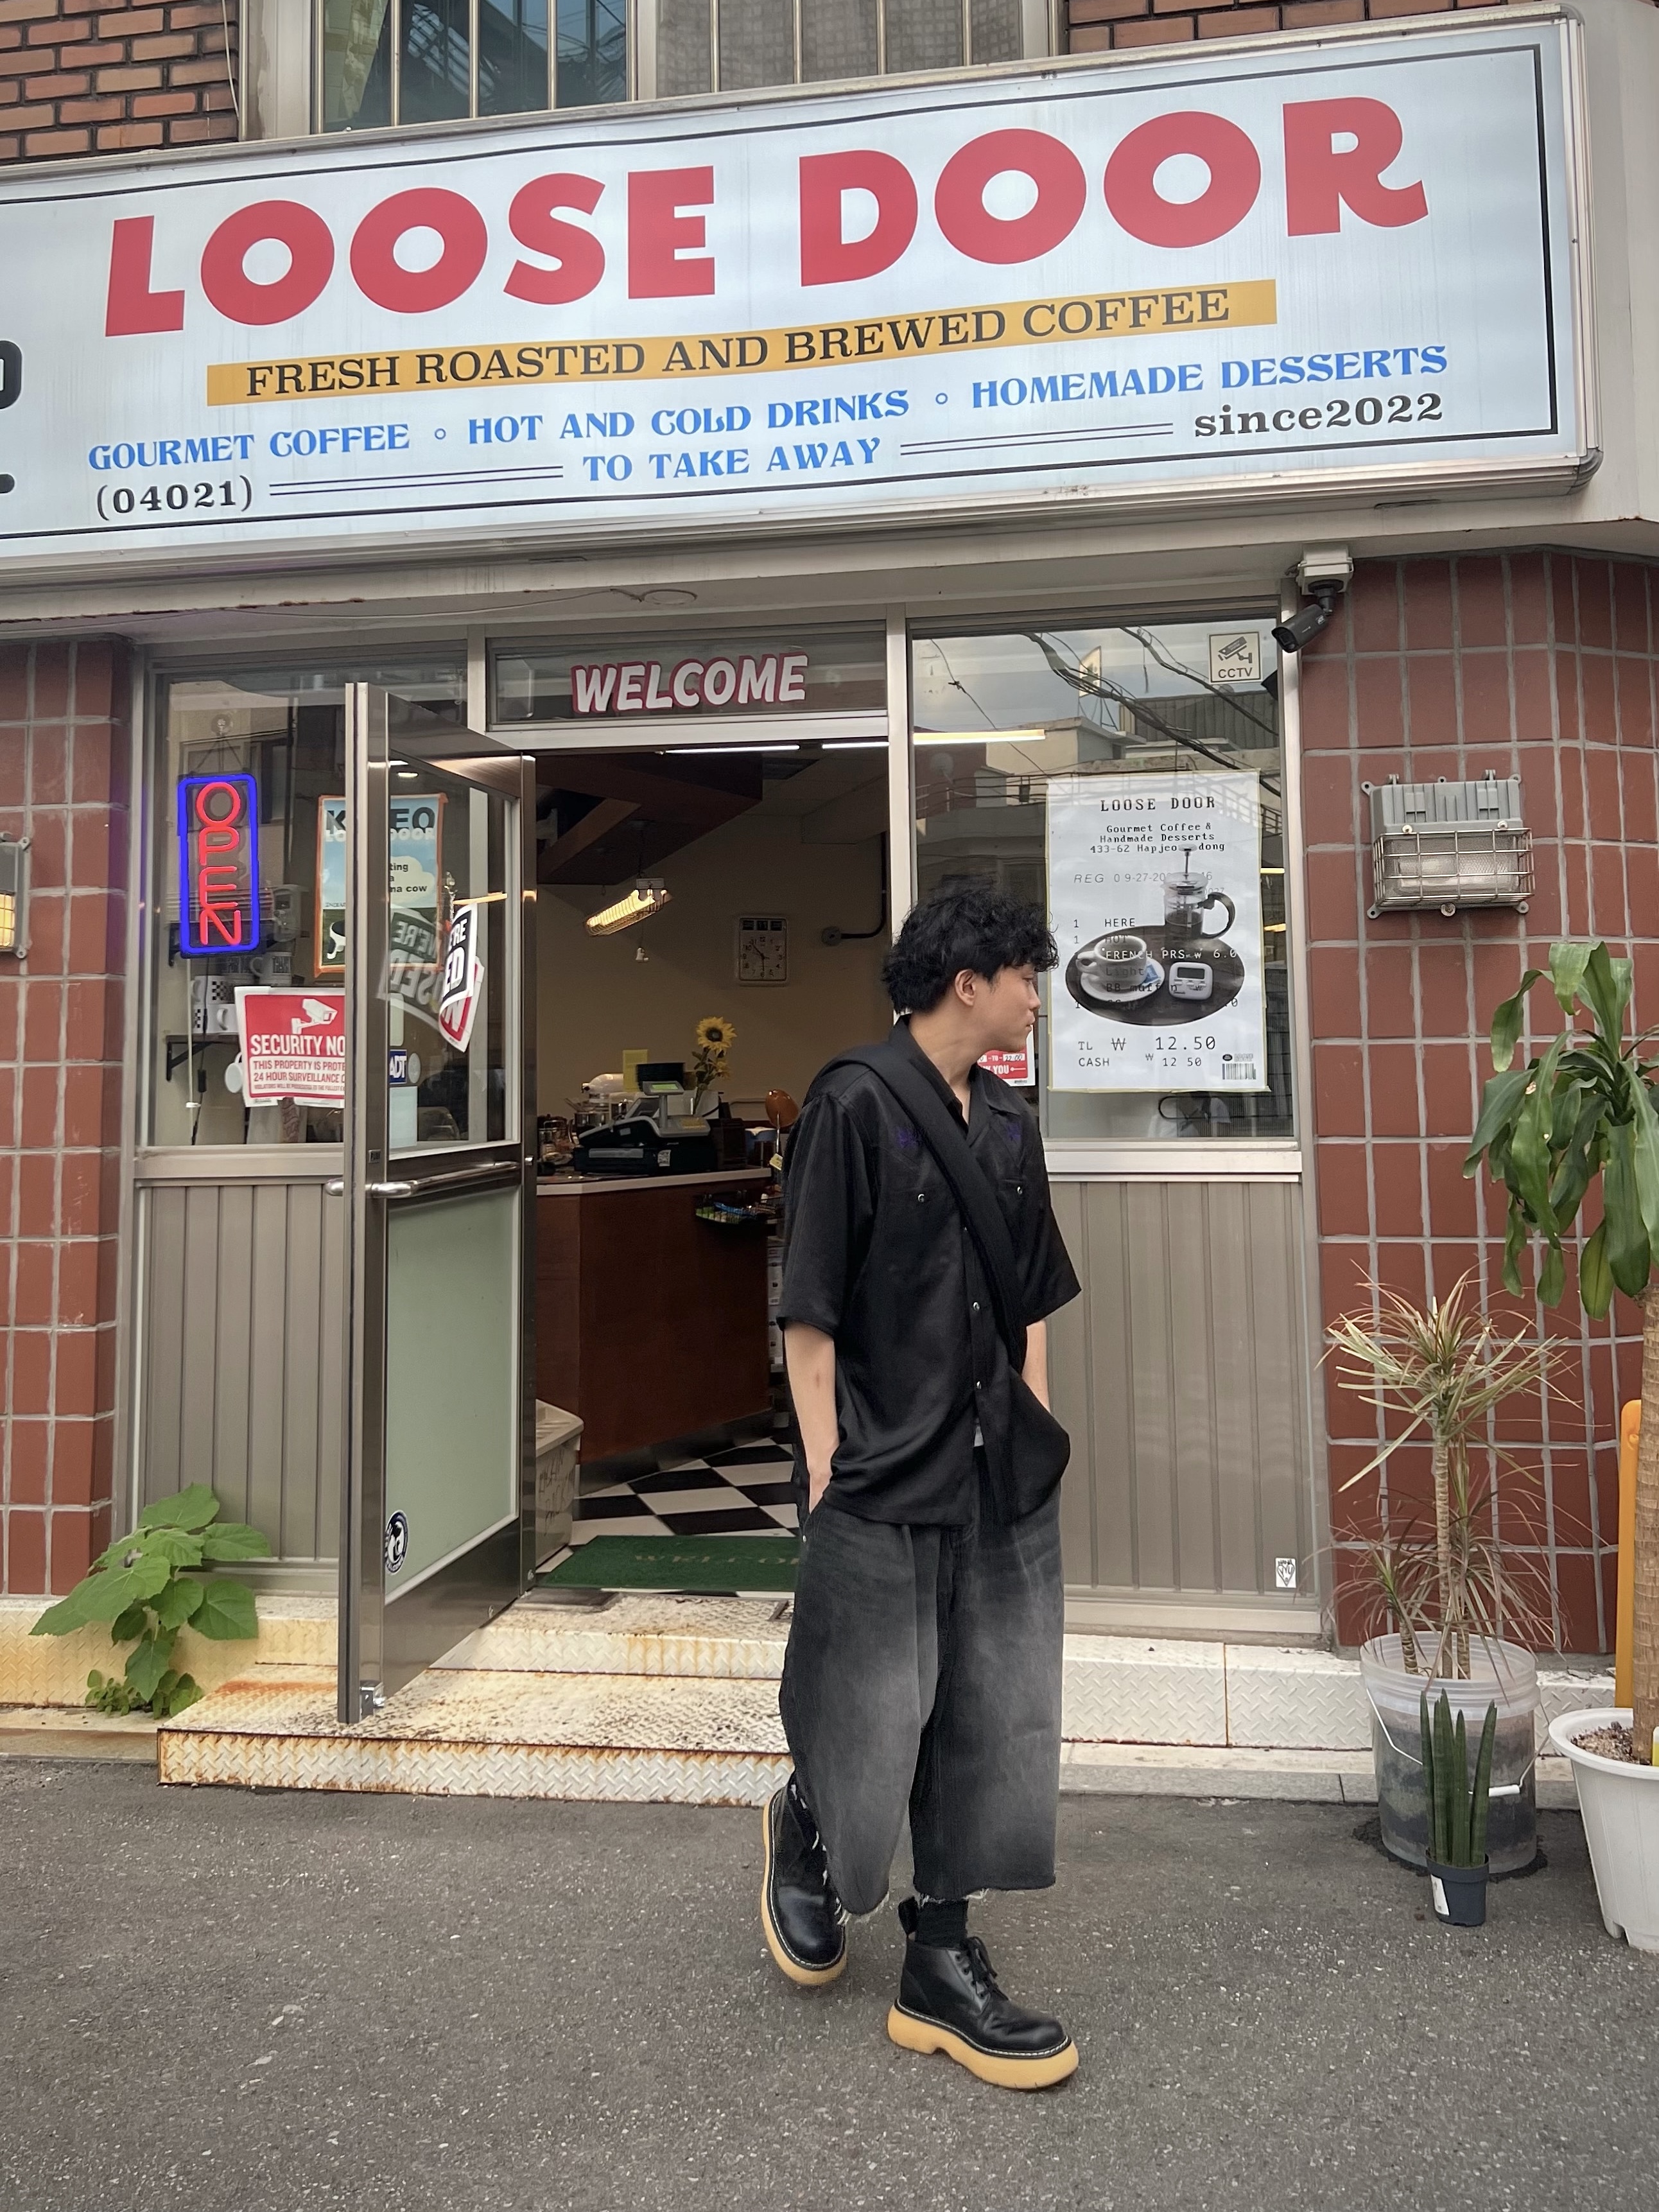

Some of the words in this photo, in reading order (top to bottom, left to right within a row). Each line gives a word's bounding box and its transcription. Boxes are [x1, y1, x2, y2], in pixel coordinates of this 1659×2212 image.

[105, 165, 715, 337] LOOSE
[799, 96, 1429, 287] DOOR
[246, 356, 400, 397] FRESH
[415, 343, 645, 385] ROASTED
[662, 335, 768, 372] AND
[785, 309, 1005, 364] BREWED
[1023, 289, 1229, 337] COFFEE
[89, 434, 255, 470] GOURMET
[270, 424, 410, 457] COFFEE
[468, 415, 543, 444] HOT
[559, 411, 634, 440] AND
[651, 405, 751, 436] COLD
[767, 389, 910, 428] DRINKS
[972, 363, 1203, 409] HOMEMADE
[1221, 345, 1448, 389] DESSERTS
[1195, 393, 1443, 437] since2022
[583, 454, 632, 482] TO
[648, 448, 750, 480] TAKE
[767, 437, 881, 472] AWAY
[96, 475, 253, 521] (04021)
[1218, 668, 1253, 678] CCTV
[571, 651, 808, 713] WELCOME
[1100, 798, 1156, 812] LOOSE
[1171, 796, 1215, 809] DOOR
[1106, 824, 1153, 833] Gourmet
[1160, 823, 1201, 832] Coffee
[1090, 844, 1130, 853] 433-62
[195, 781, 242, 946] OPEN
[1074, 873, 1105, 883] REG
[1105, 918, 1135, 927] HERE
[1105, 934, 1128, 943] HOT
[1106, 950, 1152, 959] FRENCH
[250, 1034, 322, 1056] SECURITY
[1156, 1036, 1215, 1050] 12.50
[253, 1061, 272, 1070] THIS
[274, 1061, 312, 1070] PROPERTY
[315, 1061, 321, 1070] IS
[323, 1062, 345, 1071] PROTE
[390, 1055, 407, 1079] ADT
[1079, 1058, 1110, 1067] CASH
[993, 1065, 1009, 1075] YOU
[254, 1072, 264, 1082] 24
[266, 1072, 287, 1081] HOUR
[289, 1072, 339, 1083] SURVEILLANCE
